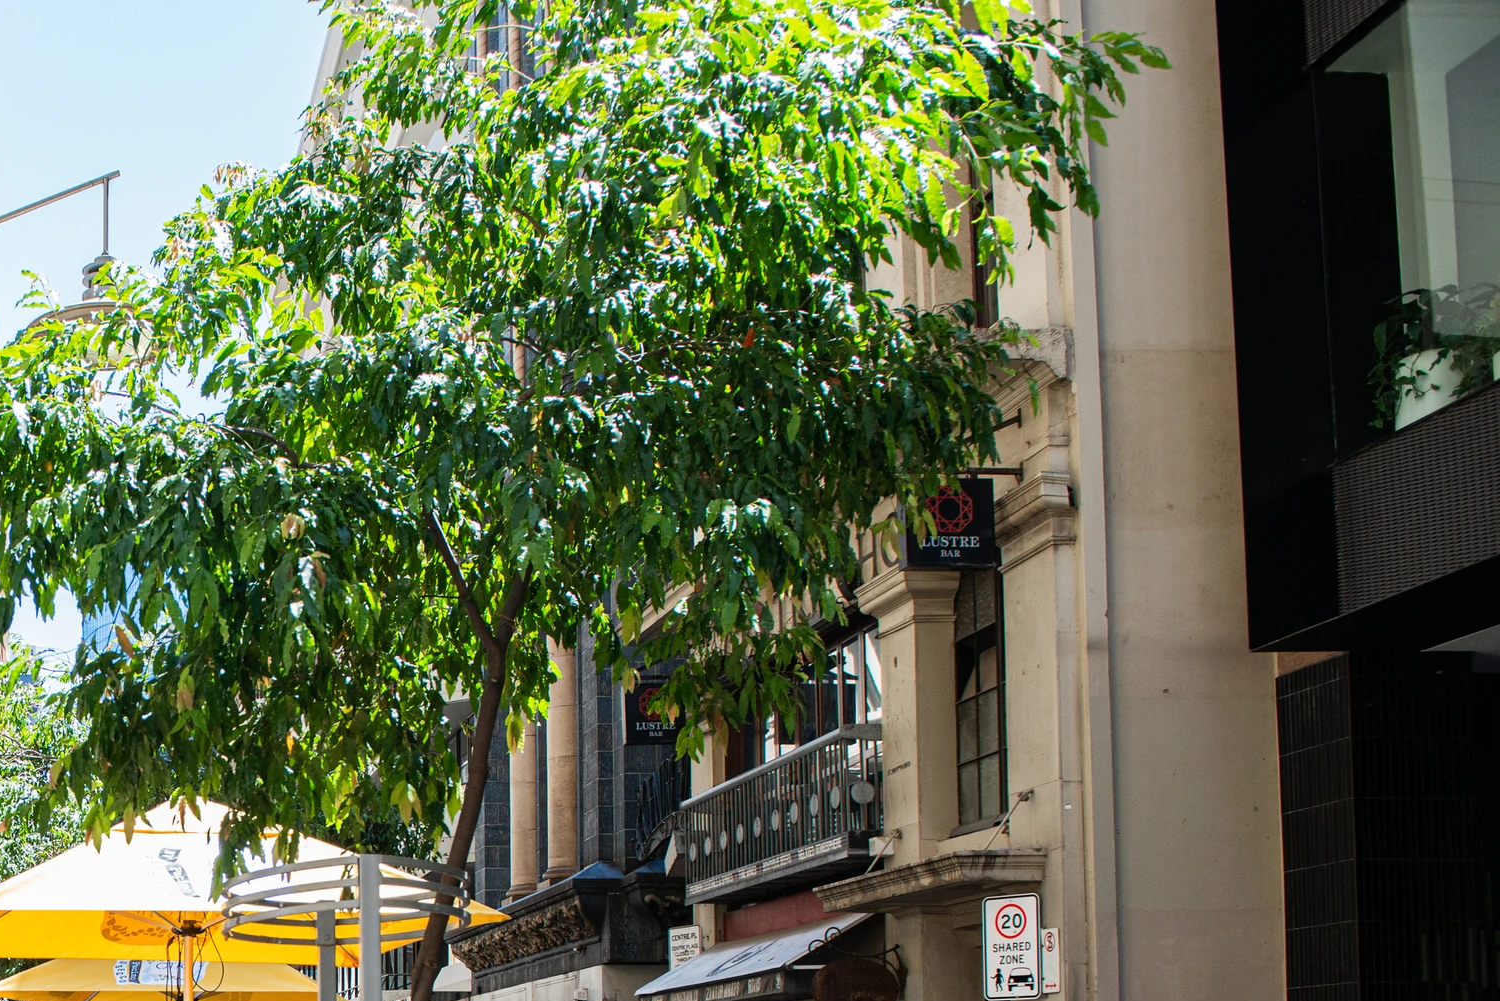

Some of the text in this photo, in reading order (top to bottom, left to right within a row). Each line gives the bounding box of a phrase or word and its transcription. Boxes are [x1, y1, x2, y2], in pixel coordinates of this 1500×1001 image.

[921, 535, 980, 548] LUSTRE
[940, 550, 961, 558] BAR
[1001, 913, 1022, 929] 20
[671, 932, 698, 942] CENTRE PL
[686, 942, 698, 950] PLACE
[992, 941, 1031, 953] SHARED
[999, 954, 1025, 965] ZONE
